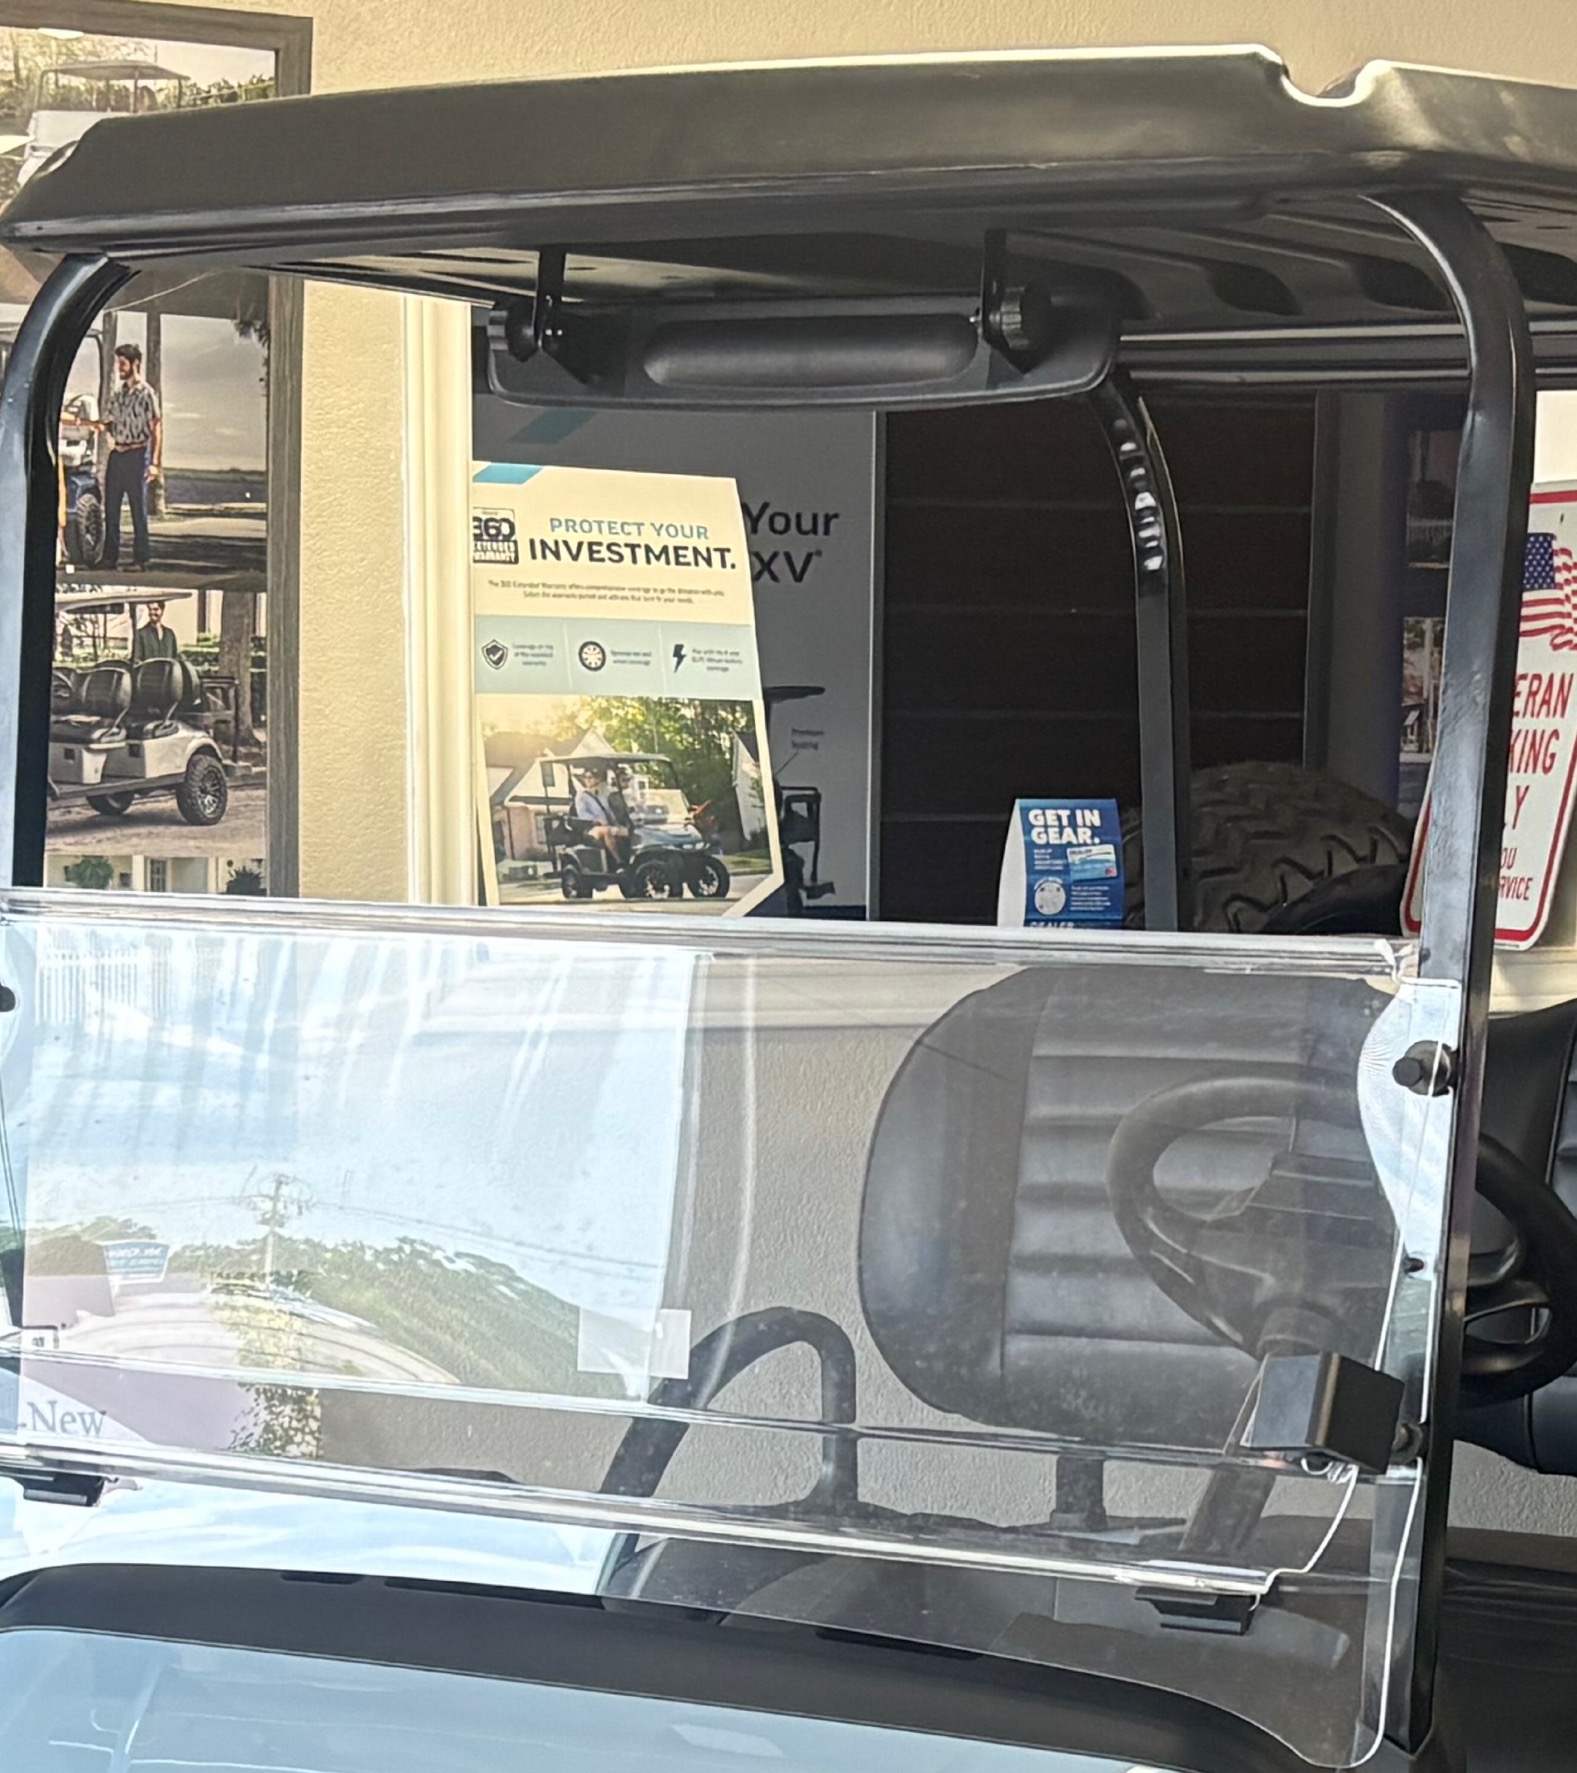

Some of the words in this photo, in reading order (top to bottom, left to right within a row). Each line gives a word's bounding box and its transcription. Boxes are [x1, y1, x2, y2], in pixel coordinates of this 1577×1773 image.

[549, 517, 645, 537] PROTECT
[650, 522, 710, 540] YOUR
[740, 501, 839, 536] Your
[528, 537, 737, 570] INVESTMENT.
[752, 550, 816, 583] XV
[1513, 672, 1574, 719] ERAN
[1509, 728, 1560, 775] KING
[1028, 808, 1071, 827] GET
[1075, 808, 1101, 827] IN
[1031, 826, 1101, 845] GEAR.
[1499, 876, 1533, 900] RVICE
